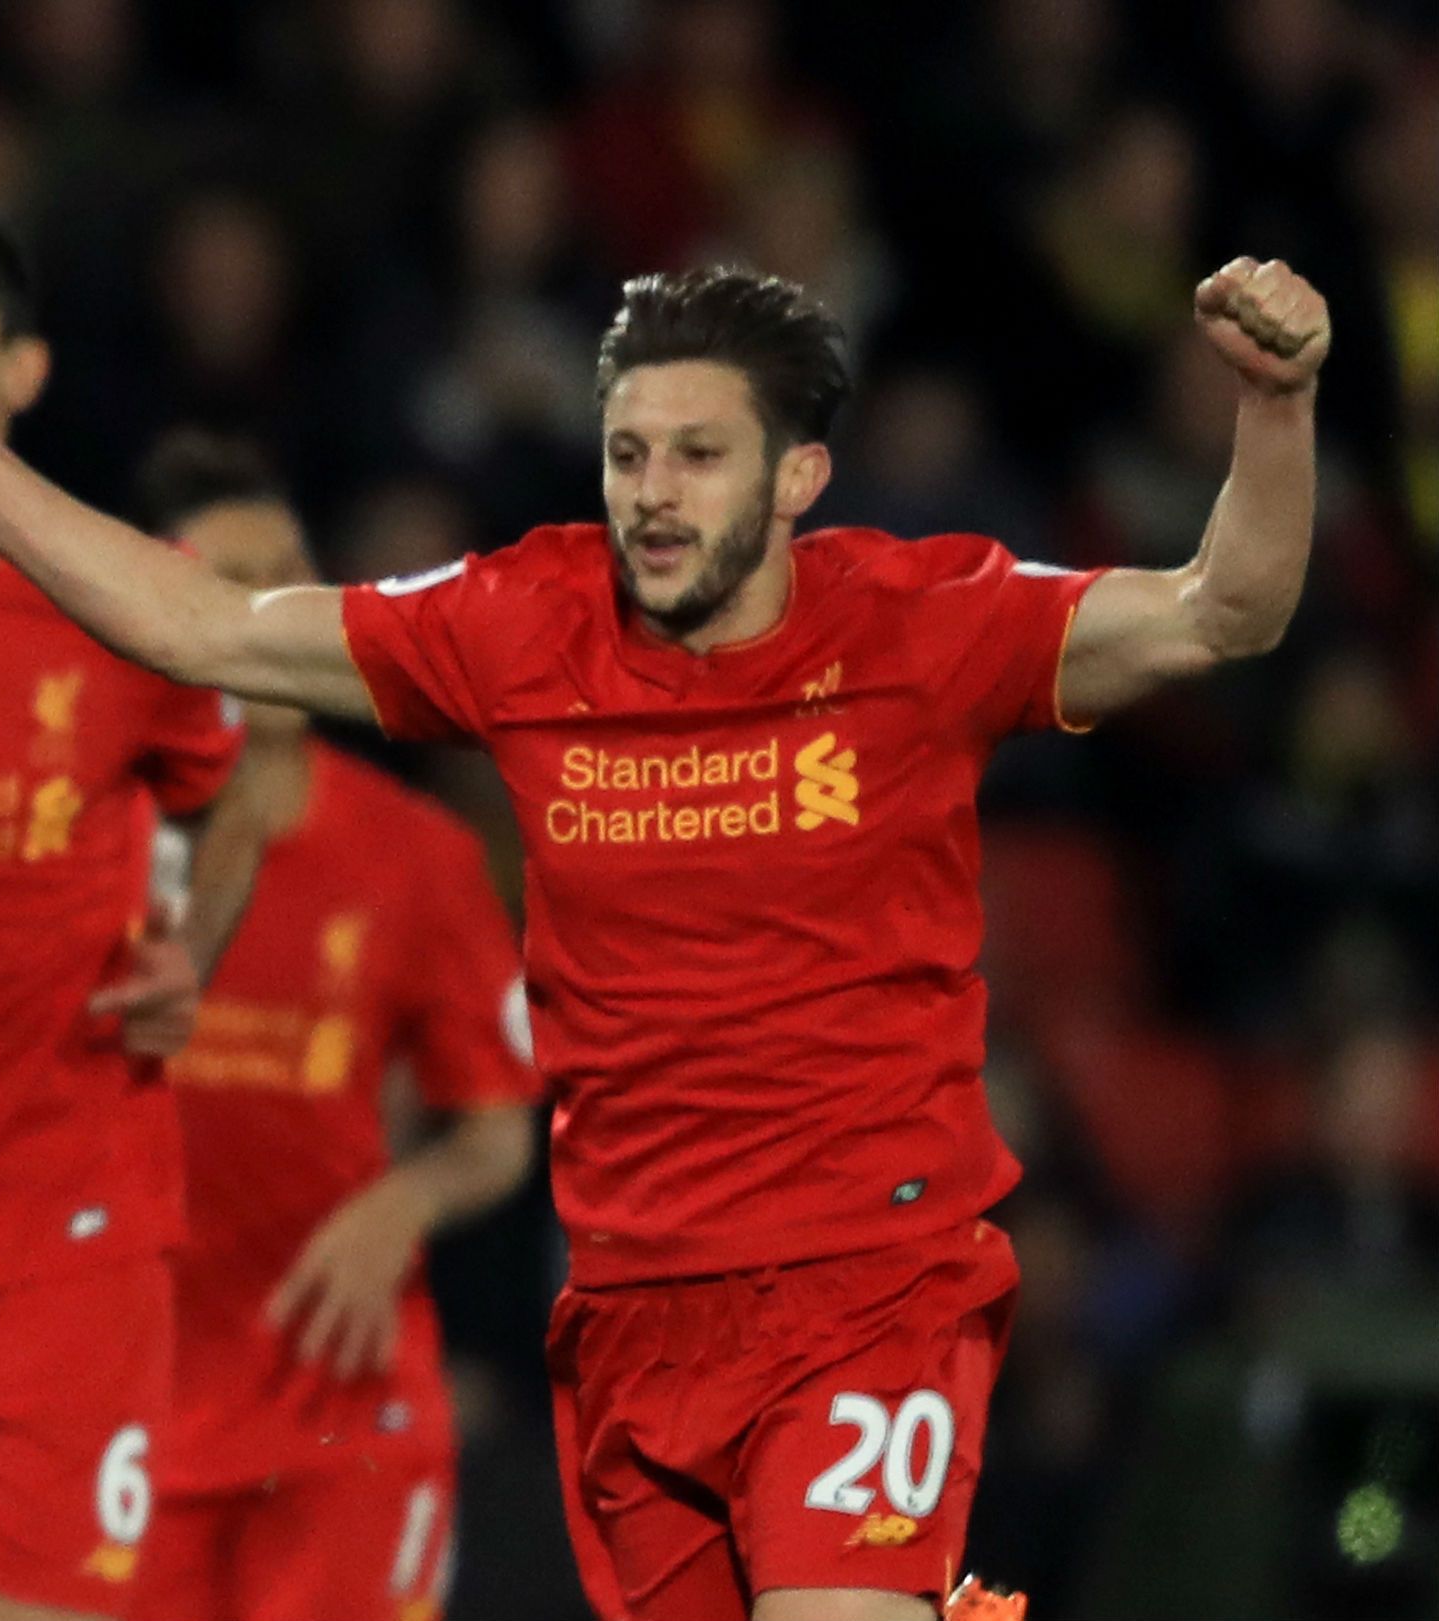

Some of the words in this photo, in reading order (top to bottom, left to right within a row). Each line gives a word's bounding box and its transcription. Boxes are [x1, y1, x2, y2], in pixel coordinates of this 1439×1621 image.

[561, 737, 779, 791] Standard
[546, 790, 780, 844] Chartered
[96, 1424, 151, 1544] 6
[804, 1389, 955, 1517] 20
